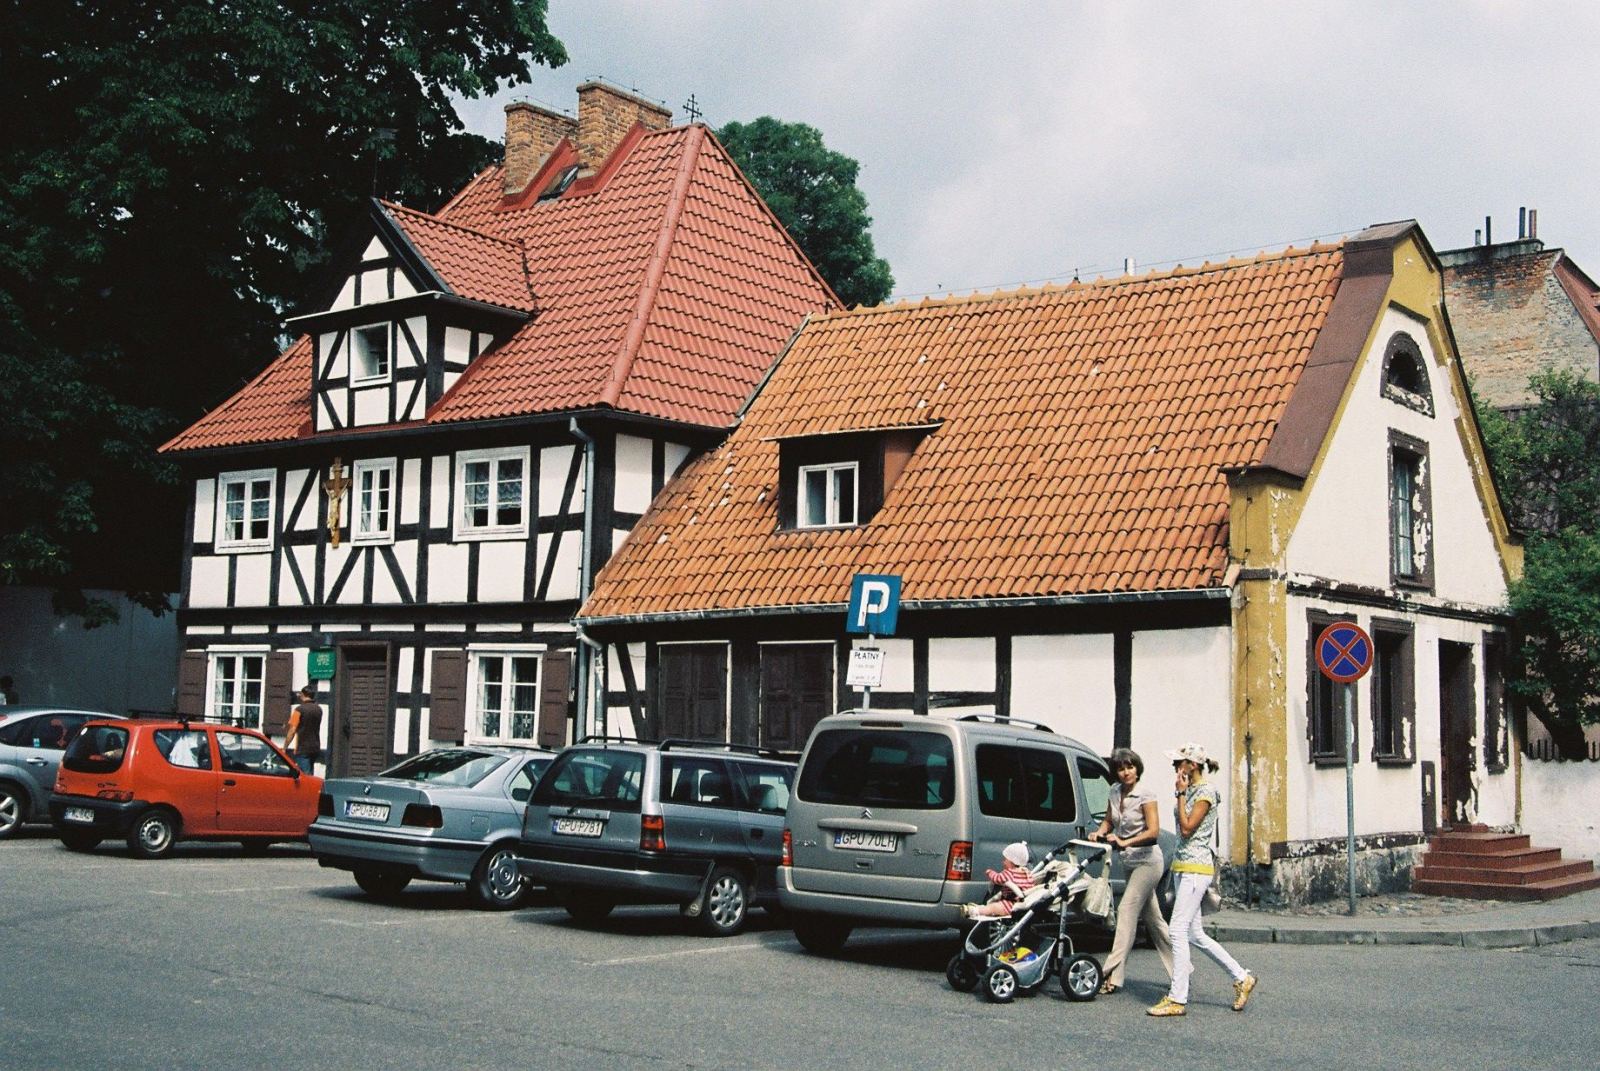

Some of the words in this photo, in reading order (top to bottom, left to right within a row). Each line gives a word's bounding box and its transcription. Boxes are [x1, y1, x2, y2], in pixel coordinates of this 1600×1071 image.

[857, 581, 890, 627] P
[854, 651, 879, 660] PŁATNY
[559, 819, 576, 832] GPU
[843, 831, 865, 845] GPU
[868, 833, 896, 848] 70LH
